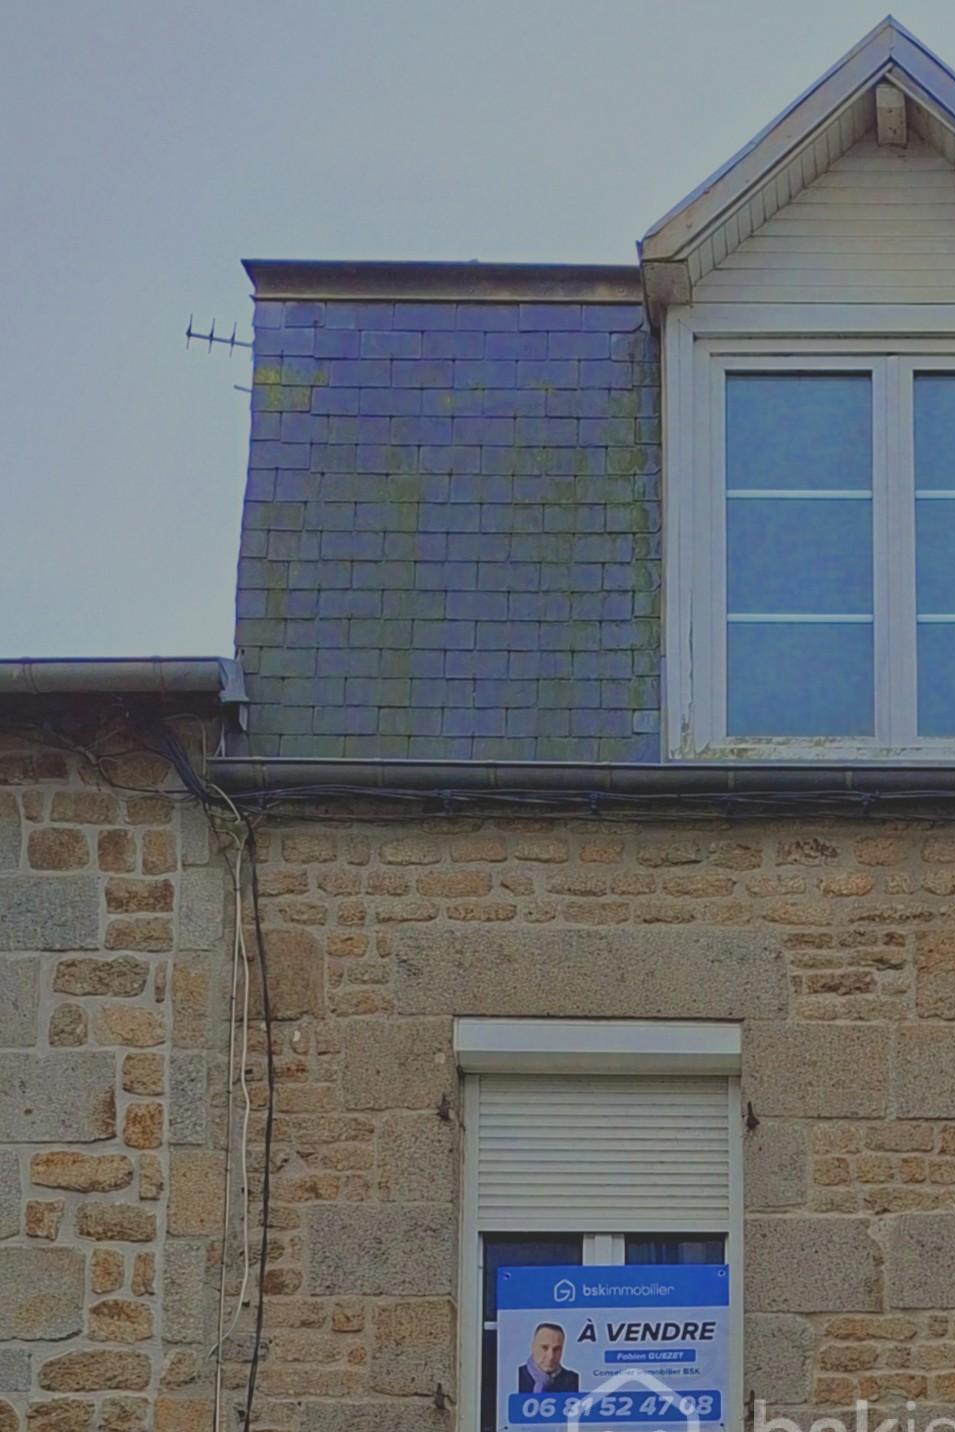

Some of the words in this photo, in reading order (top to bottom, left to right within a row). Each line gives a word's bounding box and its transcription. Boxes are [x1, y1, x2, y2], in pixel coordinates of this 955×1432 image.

[582, 1284, 675, 1296] bskimmobilier
[577, 1318, 597, 1342] À
[606, 1321, 716, 1341] VENDRE
[593, 1368, 637, 1377] Conseier
[638, 1367, 681, 1376] mobilier
[683, 1367, 701, 1375] BSK
[522, 1398, 556, 1417] 06
[563, 1397, 593, 1416] 81
[599, 1396, 634, 1416] 52
[640, 1395, 675, 1415] 47
[680, 1395, 714, 1415] 08
